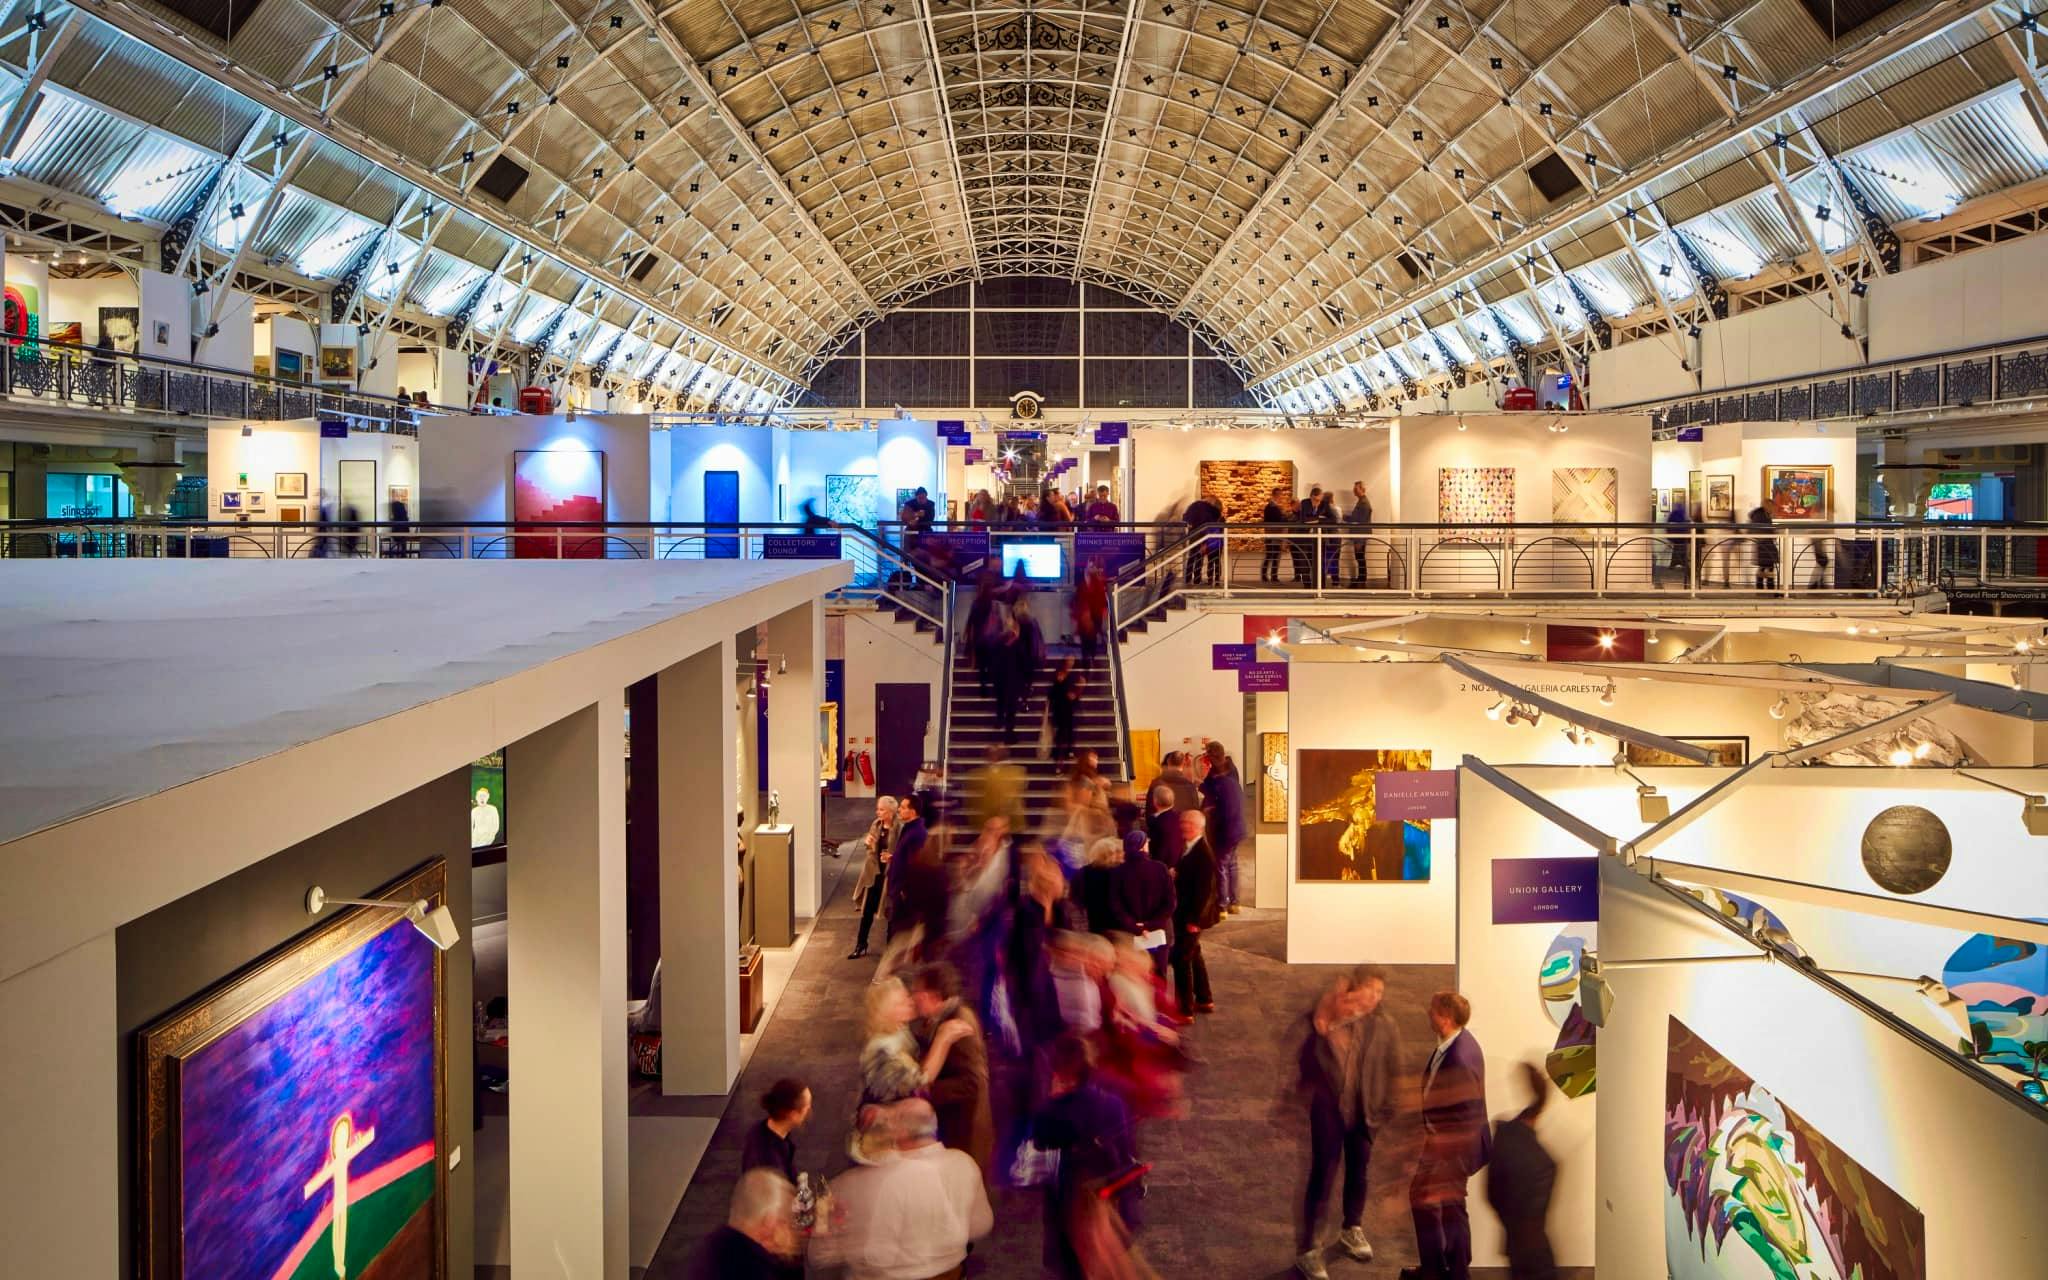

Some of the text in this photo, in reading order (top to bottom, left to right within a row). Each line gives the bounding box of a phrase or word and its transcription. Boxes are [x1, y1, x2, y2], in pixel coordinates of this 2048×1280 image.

[948, 537, 986, 545] RECEPTION
[1956, 591, 1980, 599] Ground
[1981, 591, 1999, 599] Floor
[2000, 591, 2039, 599] Showrooms
[1460, 684, 1466, 692] 2
[1471, 684, 1485, 692] NO
[1525, 684, 1558, 693] GALERIA
[1560, 685, 1590, 693] CARLES
[1383, 791, 1418, 799] DANIELLE
[1509, 885, 1583, 894] UNION GALLERY
